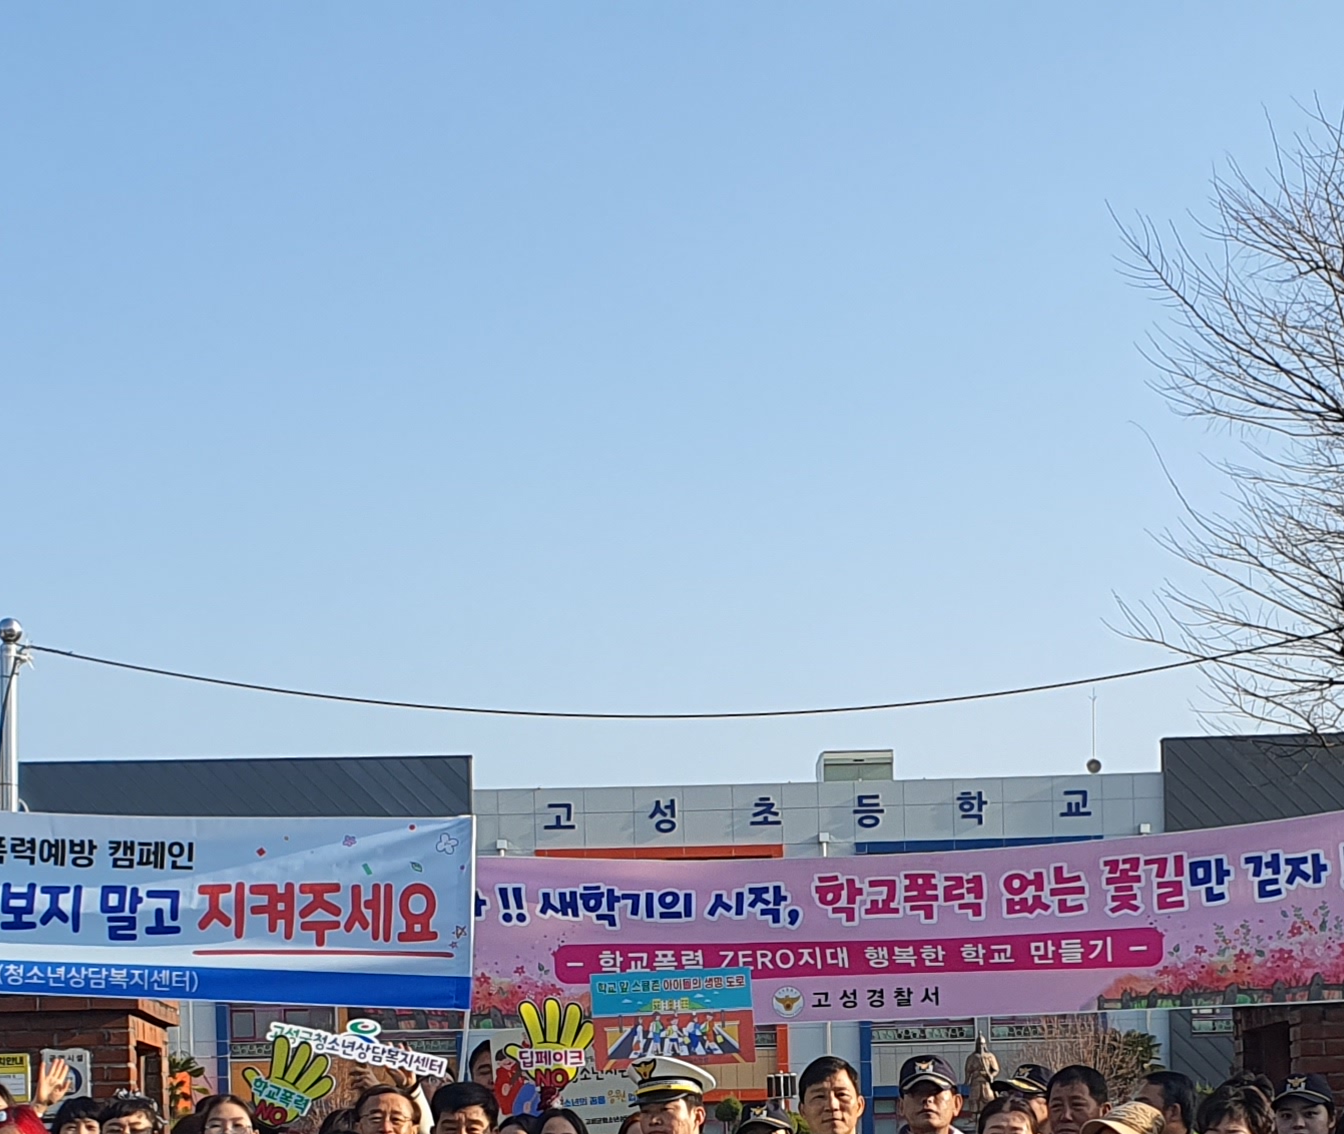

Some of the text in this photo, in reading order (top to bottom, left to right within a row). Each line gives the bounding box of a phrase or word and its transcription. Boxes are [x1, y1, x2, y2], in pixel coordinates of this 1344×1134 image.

[108, 839, 195, 871] 캠페인
[539, 885, 694, 928] 새학기의
[707, 884, 801, 927] 시작,
[814, 872, 985, 923] 학교폭력
[1003, 866, 1087, 916] 없는
[1102, 854, 1231, 915] 꽃길만
[1244, 852, 1329, 900] 걷자
[100, 884, 181, 942] 말고
[197, 882, 439, 947] 지켜주세요
[598, 936, 1113, 972] 학교폭력 ZERO지대 행복한 학교 만들기
[811, 986, 941, 1009] 고성경찰서
[518, 1049, 584, 1069] 딥페이크
[535, 1069, 569, 1088] NO
[252, 1076, 312, 1115] 학교폭력
[256, 1101, 288, 1126] NO
